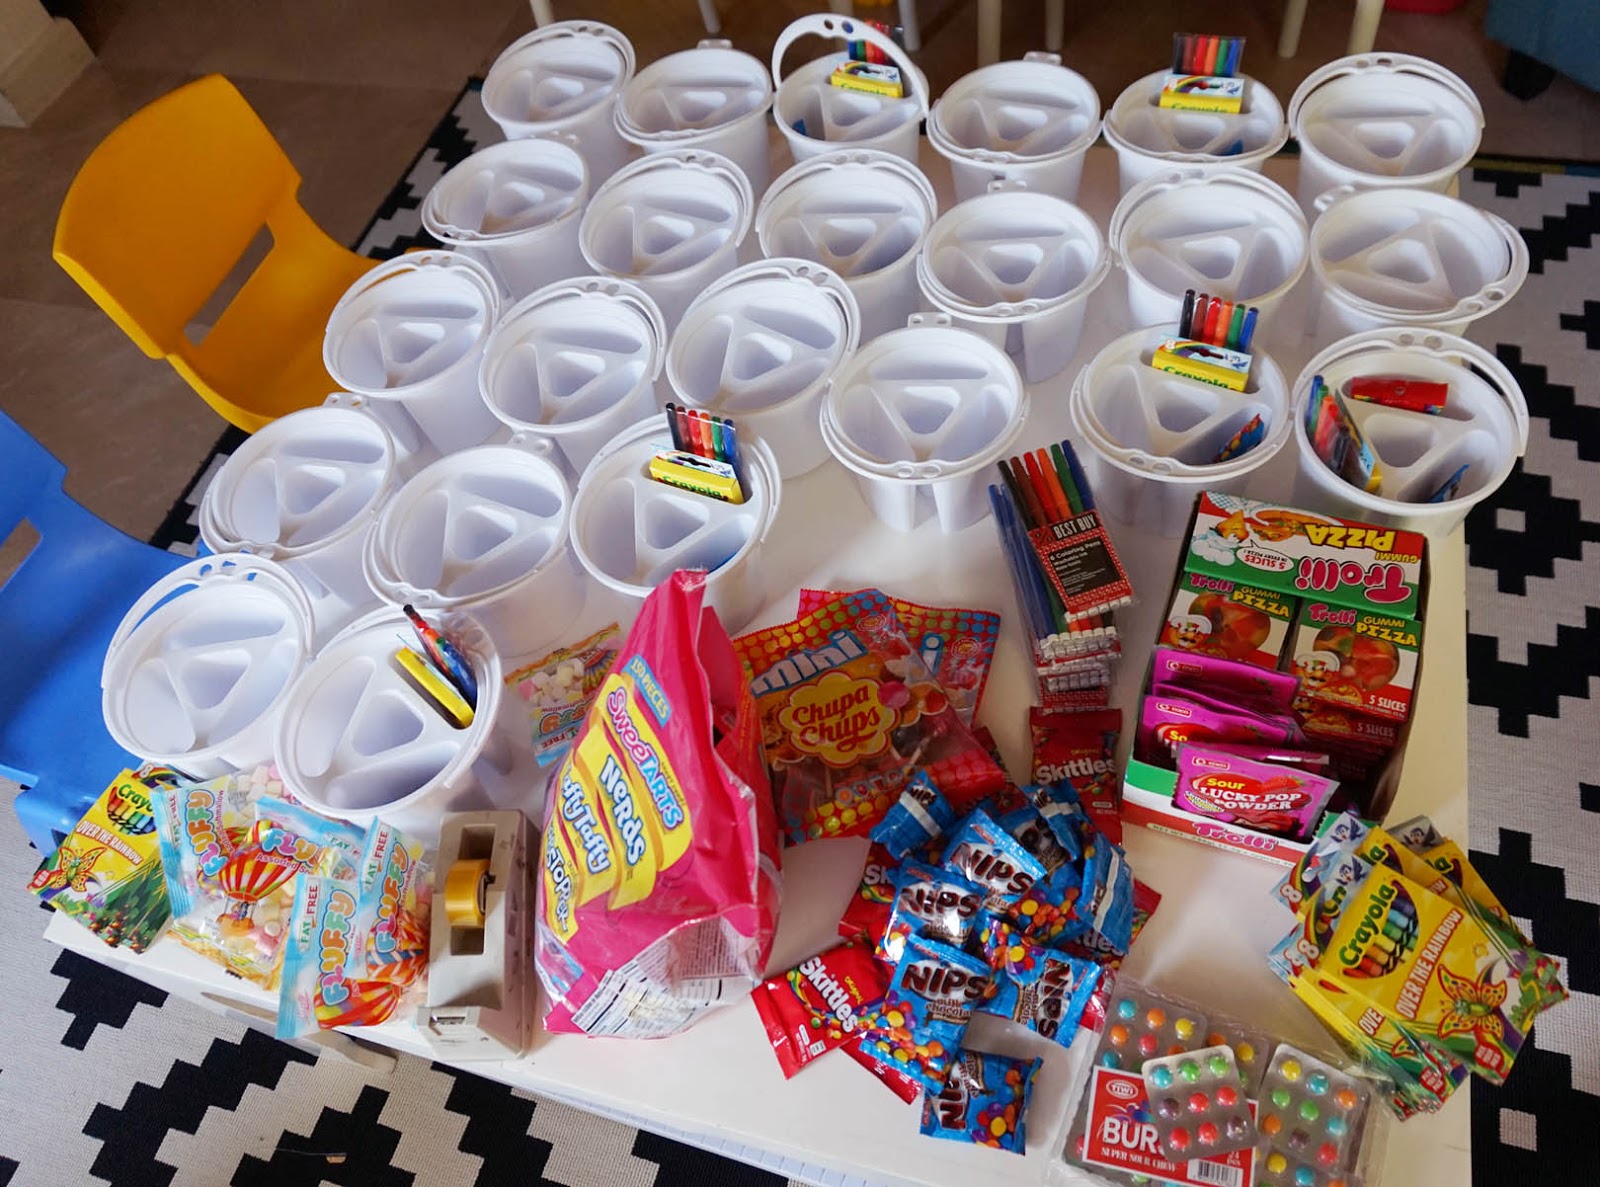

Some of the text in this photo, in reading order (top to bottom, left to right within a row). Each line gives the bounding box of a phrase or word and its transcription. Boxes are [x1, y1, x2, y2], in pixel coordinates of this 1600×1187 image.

[1053, 514, 1097, 539] BEST BUY
[1305, 523, 1396, 552] PIZZA
[1244, 554, 1286, 570] 5 SLICES
[1375, 552, 1418, 564] GUMMI
[1190, 573, 1235, 593] Trolli
[1240, 586, 1280, 600] GUMMI
[1294, 557, 1412, 603] Trolli
[1232, 591, 1290, 617] PIZZA
[1308, 603, 1357, 624] Trolli
[1356, 622, 1418, 647] PIZZA
[1363, 616, 1405, 628] GUMMI
[750, 630, 868, 698] mini
[630, 659, 668, 719] 150 PIECES
[792, 685, 869, 726] Chupa
[1369, 695, 1376, 705] 5
[1377, 697, 1407, 712] SLICES
[799, 706, 881, 753] Chups
[1170, 730, 1188, 742] So
[1366, 724, 1394, 738] SLICES
[139, 764, 154, 779] 8
[1035, 757, 1115, 785] Skittles
[1206, 778, 1246, 790] Sour
[1200, 787, 1260, 803] LUCKY
[1263, 792, 1302, 803] POP
[76, 820, 143, 865] OVER THE RAINBOW
[261, 827, 320, 867] FLU
[330, 836, 351, 850] FAT
[1192, 822, 1279, 851] Trolli
[256, 853, 298, 870] Assorted
[365, 831, 388, 885] FAT FREE
[951, 842, 1035, 895] NIPS
[898, 886, 982, 918] NIPS
[1280, 884, 1302, 903] 8
[300, 885, 318, 944] FAT FREE
[1340, 884, 1395, 966] Crayola
[1298, 938, 1320, 958] 8
[1421, 909, 1463, 964] RAINBOW
[901, 964, 990, 999] NIPS
[1409, 960, 1433, 987] THE
[799, 956, 859, 1033] Skittles
[1037, 958, 1071, 1038] NIPS
[1396, 982, 1424, 1019] OVER
[1358, 1008, 1385, 1036] OVE
[1111, 1083, 1134, 1095] TIWI
[1102, 1116, 1165, 1156] BUR
[1100, 1147, 1128, 1161] SUPER
[1129, 1153, 1152, 1165] SOUR
